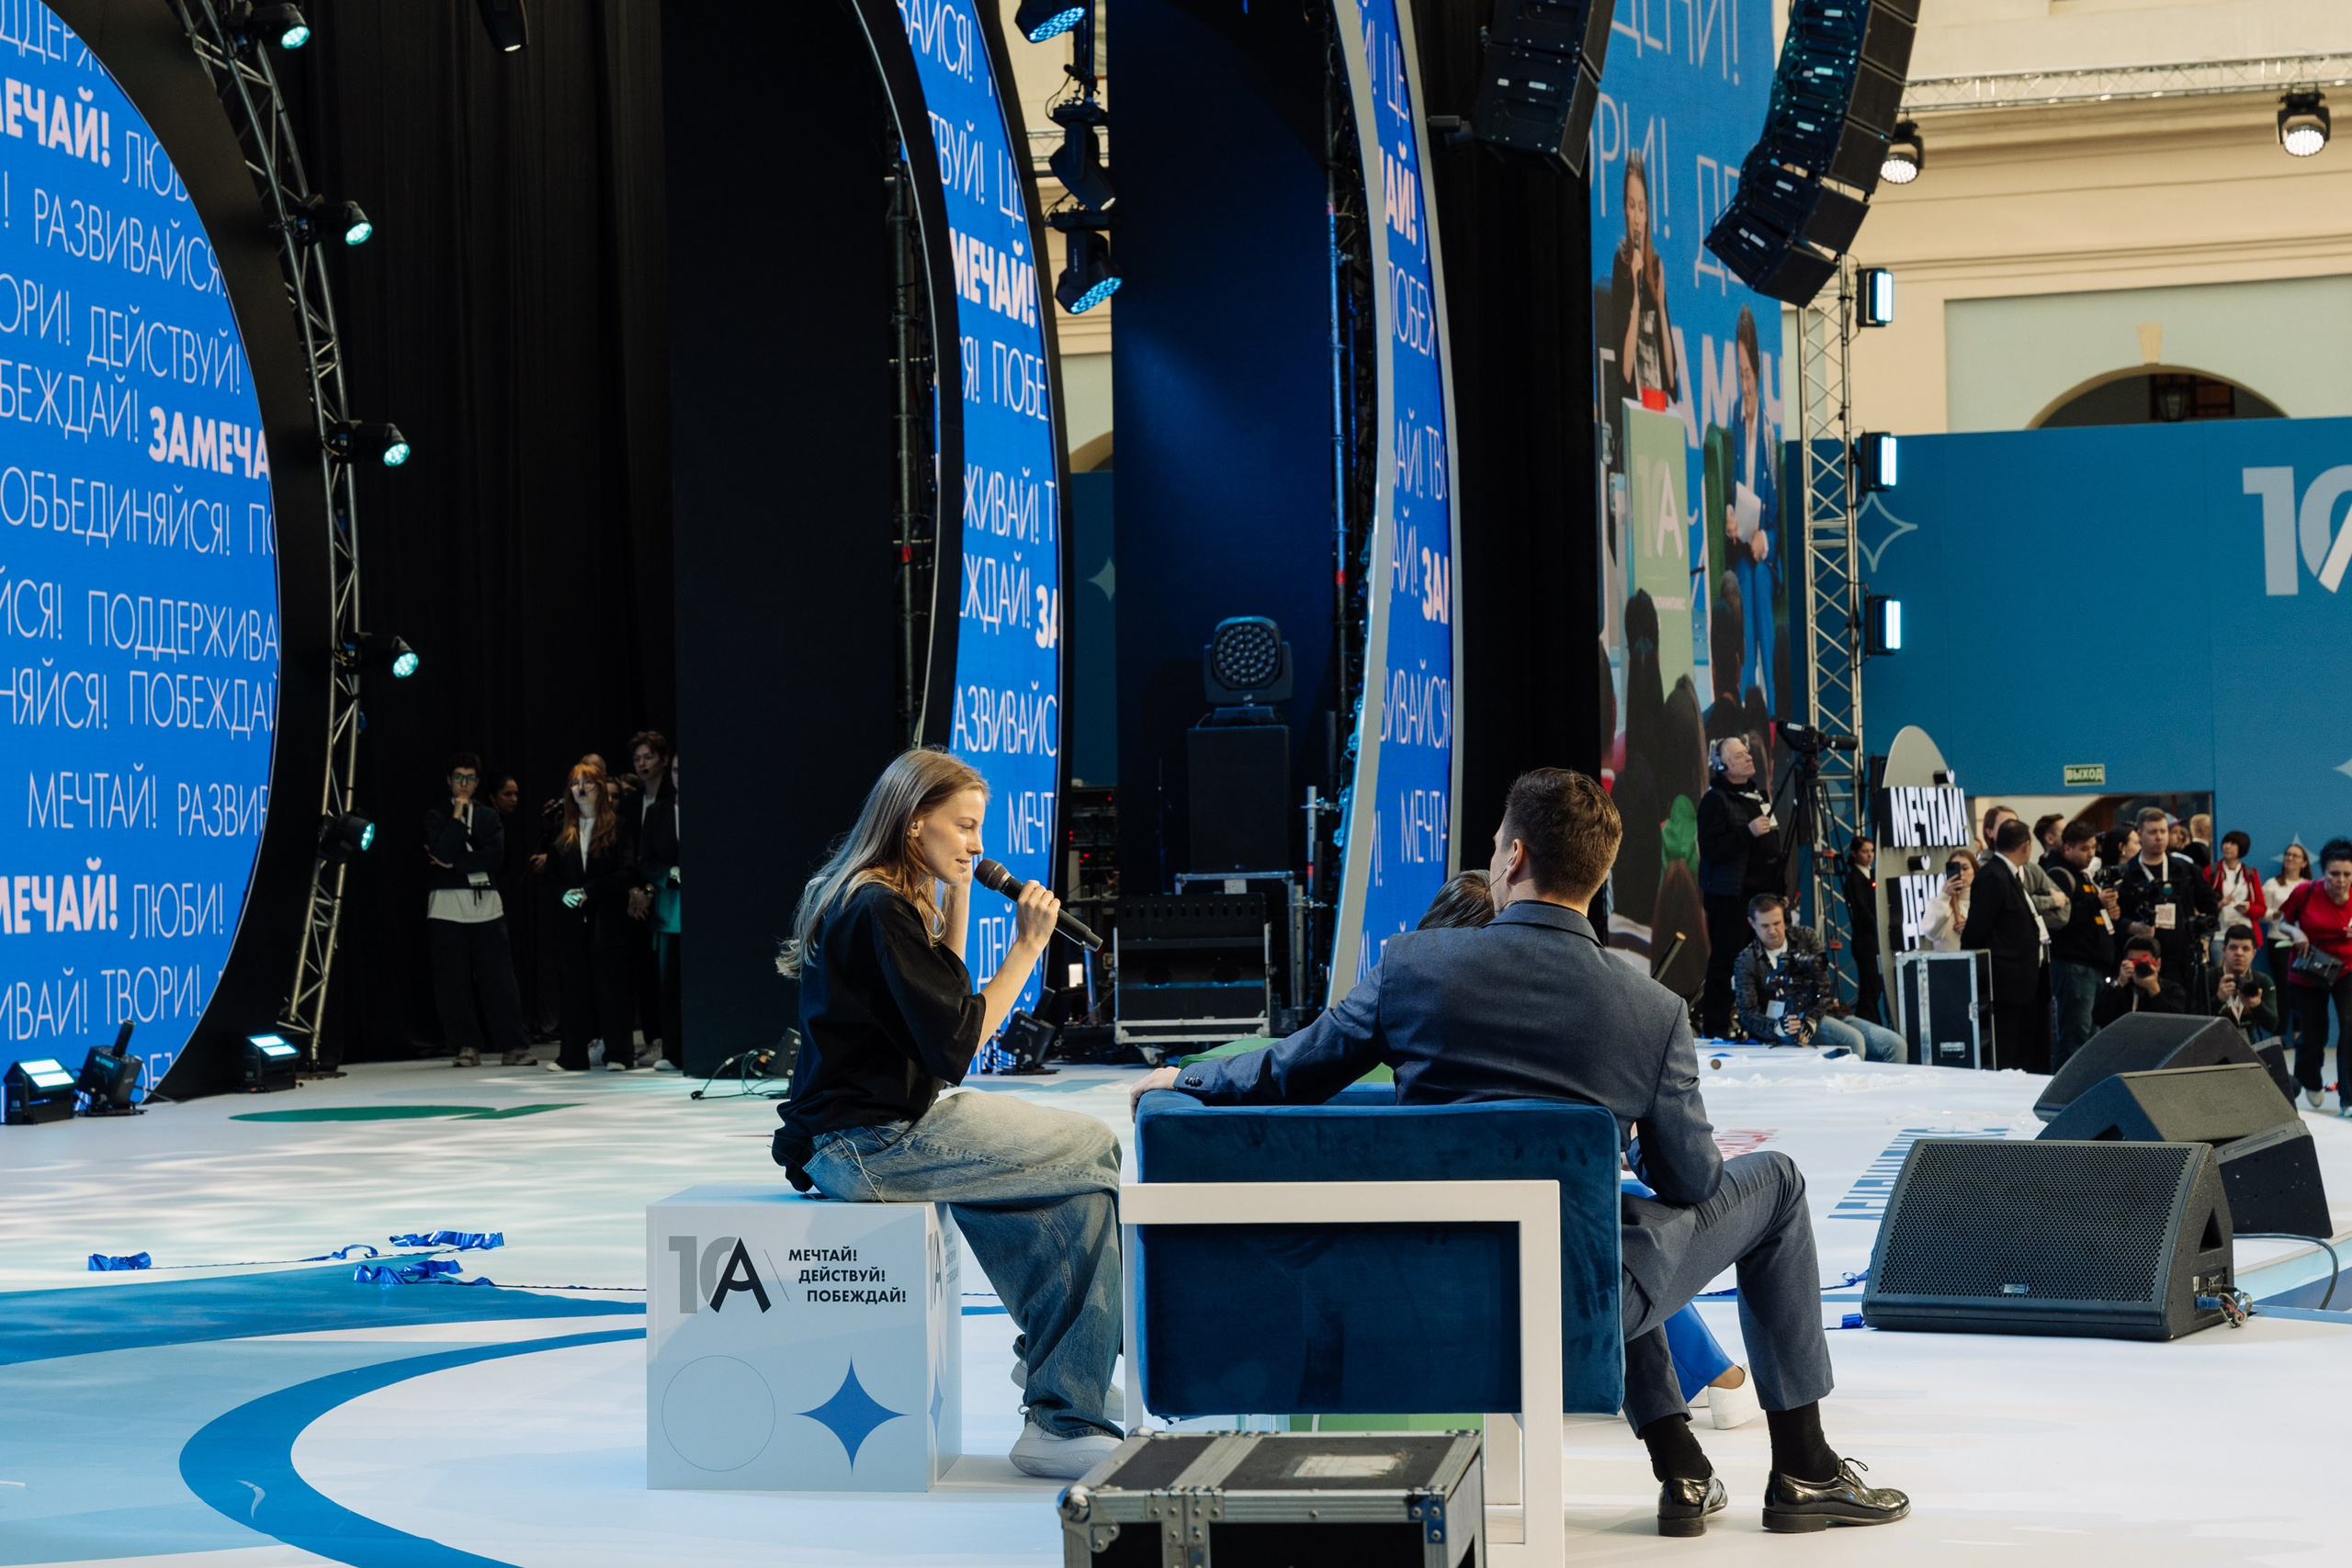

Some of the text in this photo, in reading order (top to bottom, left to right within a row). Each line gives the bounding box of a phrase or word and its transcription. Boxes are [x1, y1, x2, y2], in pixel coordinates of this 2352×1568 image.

[87, 304, 241, 395] ДЕЙСТВУЙ!
[960, 336, 1049, 421] Я! ПОБЕ
[0, 467, 231, 557] ОБЪЕДИНЯЙСЯ!
[89, 591, 279, 663] ПОДДЕРЖИВА
[959, 551, 1031, 636] ЖДАЙ!
[28, 762, 157, 829] МЕЧТАЙ!
[2066, 767, 2104, 782] ВЫХОД
[1890, 769, 1970, 848] МЕЧТАЙ!
[130, 883, 224, 940] ЛЮБИ!
[101, 964, 201, 1026] ТВОРИ!
[788, 1246, 857, 1262] МЕЧТАЙ!
[798, 1266, 886, 1284] ДЕЙСТВУЙ!
[807, 1287, 907, 1305] ПОБЕЖДАЙ!
